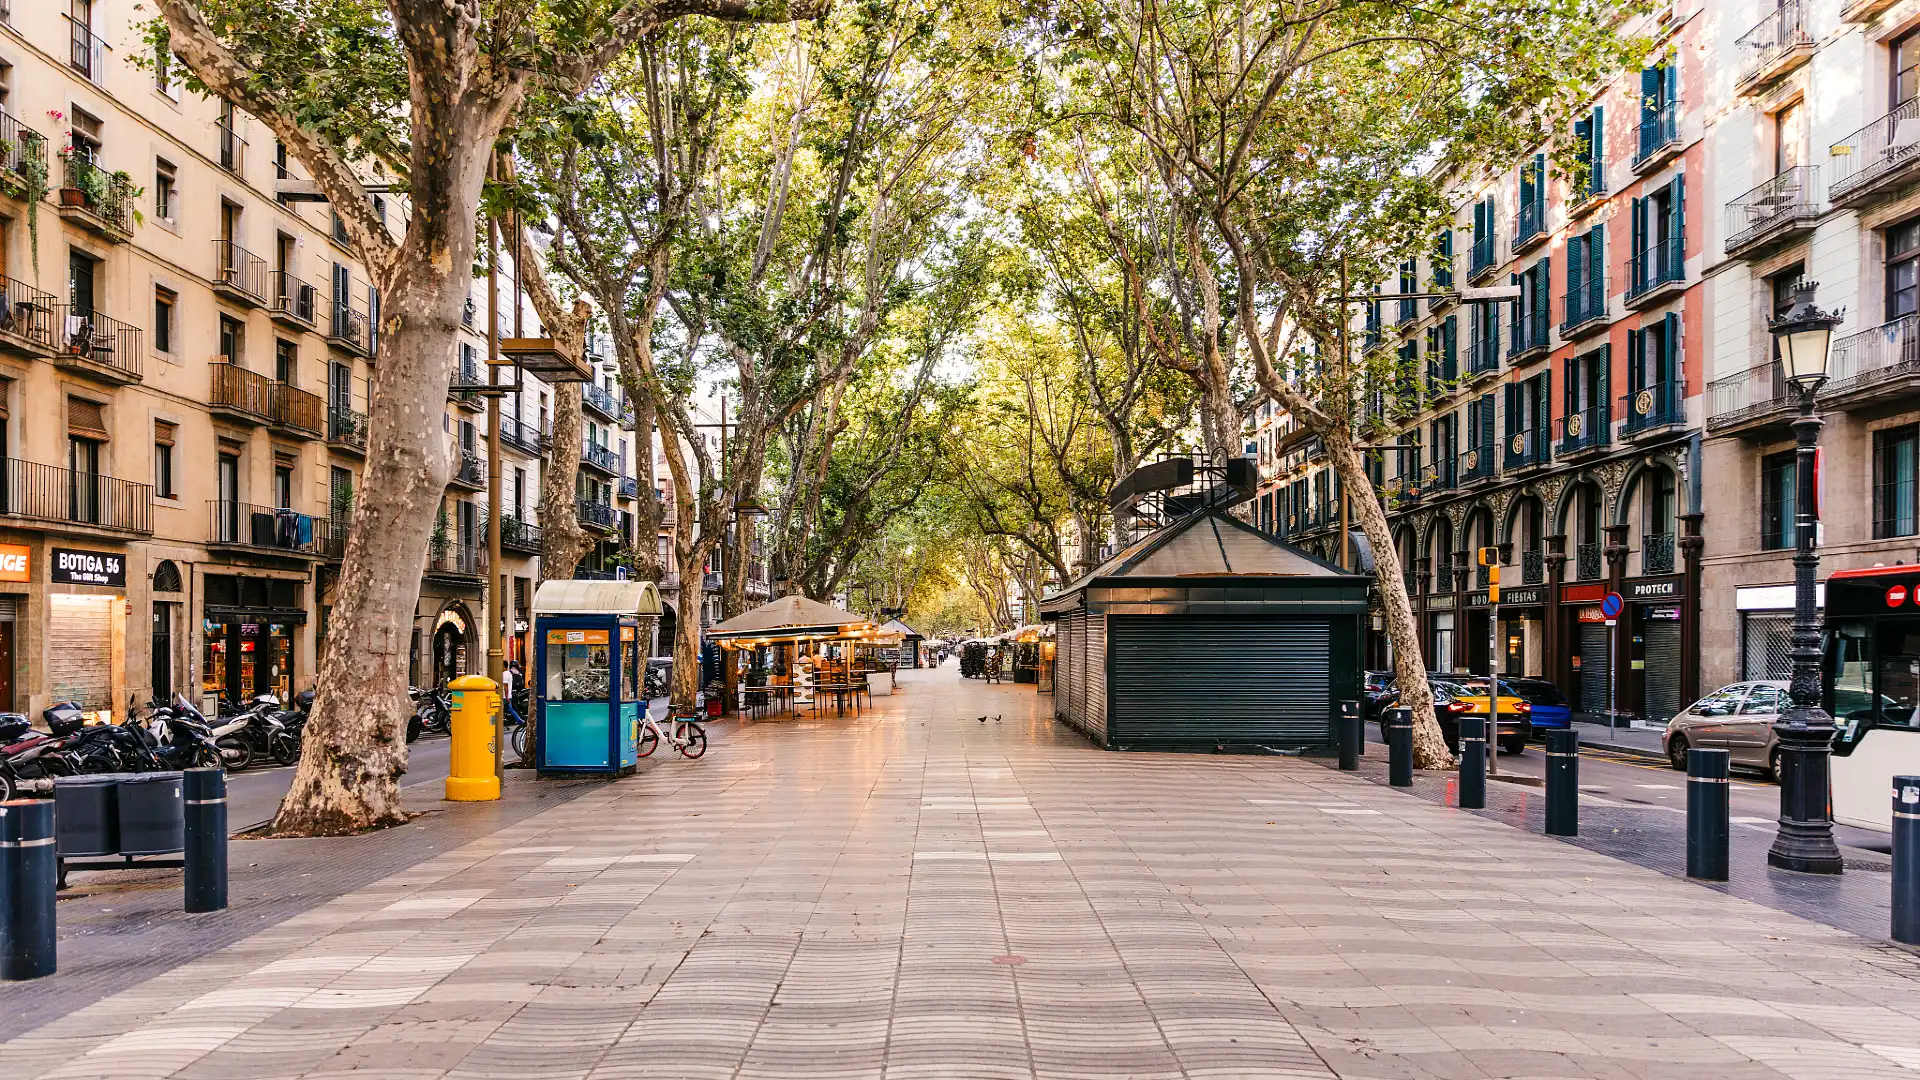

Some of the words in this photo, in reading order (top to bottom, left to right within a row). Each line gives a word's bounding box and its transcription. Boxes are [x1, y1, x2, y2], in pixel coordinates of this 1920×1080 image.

[59, 552, 104, 573] BOTIGA
[106, 557, 120, 574] 56
[70, 571, 82, 581] The
[94, 573, 109, 585] Shop
[1635, 583, 1674, 595] PROTECH
[1472, 594, 1490, 606] BOD
[1507, 591, 1537, 603] FIESTAS
